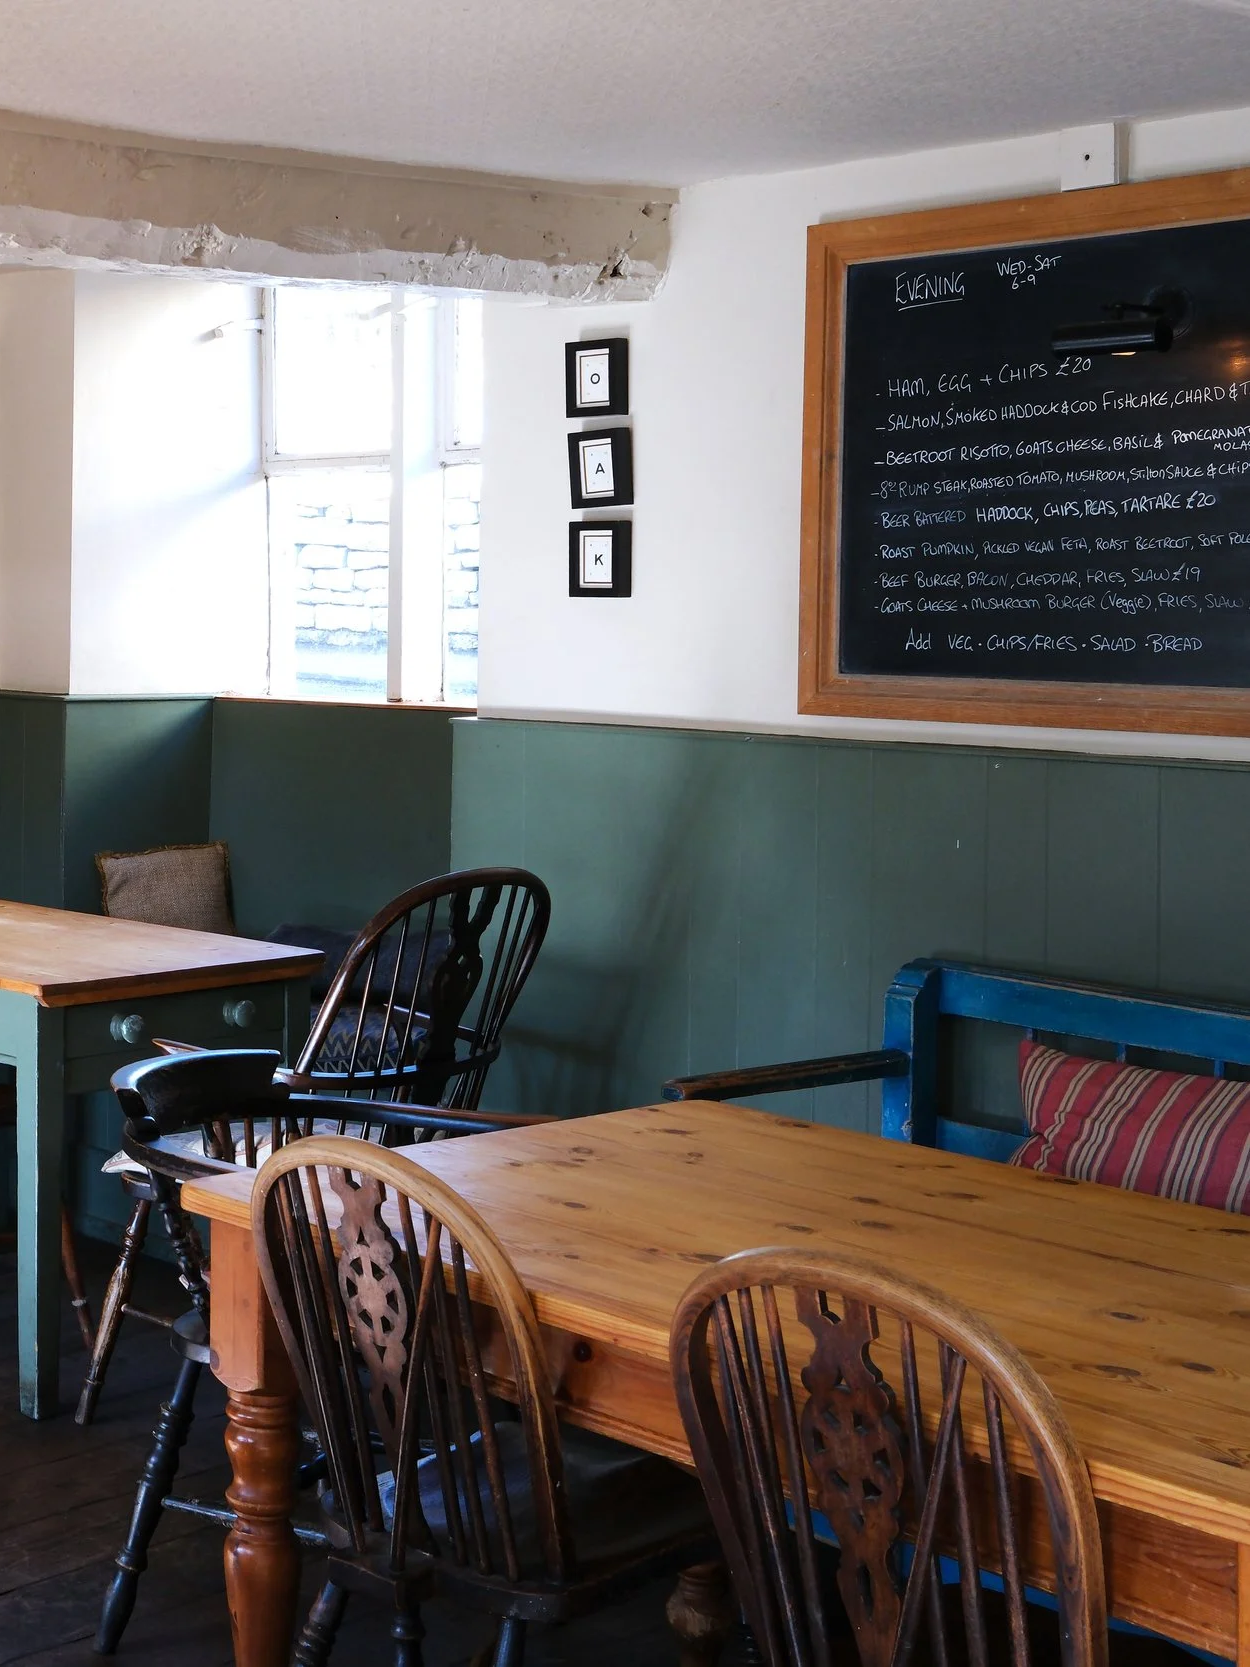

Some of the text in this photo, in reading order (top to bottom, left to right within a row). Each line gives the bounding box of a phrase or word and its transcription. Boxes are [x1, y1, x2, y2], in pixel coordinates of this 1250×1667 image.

[996, 255, 1062, 276] WED-SAT
[895, 272, 965, 304] EVENING
[1011, 274, 1036, 290] 6-9
[590, 373, 601, 385] O
[888, 357, 1092, 397] HAM, EGG CHIPS £20
[946, 407, 998, 427] SMOKED
[1001, 401, 1060, 420] HADDOCK
[1070, 400, 1098, 415] COD
[1174, 387, 1227, 405] CHARD
[886, 447, 956, 466] BEETROOT
[1016, 440, 1053, 458] GOATS
[595, 463, 606, 475] A
[899, 482, 930, 498] RUMP
[971, 476, 1014, 492] ROASTED
[1166, 464, 1204, 480] SAUCE
[881, 512, 910, 529] BEER
[914, 510, 967, 527] BATTERED
[1121, 493, 1182, 514] TARTARE
[1186, 490, 1217, 510] £20
[880, 544, 916, 560] ROAST
[982, 539, 1020, 555] PICKLED
[1024, 539, 1055, 553] VEGAN
[1096, 536, 1129, 551] ROAST
[1197, 533, 1225, 547] SOFT
[595, 554, 605, 566] K
[880, 572, 910, 589] BEEF
[1131, 567, 1170, 583] SLAW
[1171, 562, 1201, 582] £19
[880, 597, 914, 614] GOATS
[917, 597, 958, 612] CHEESE
[971, 597, 1041, 611] MUSHROOM
[1045, 593, 1096, 611] BURGER
[905, 627, 932, 651] Add
[947, 634, 974, 652] VEG
[1090, 634, 1136, 652] SALAD
[1147, 633, 1203, 653] BREAD
